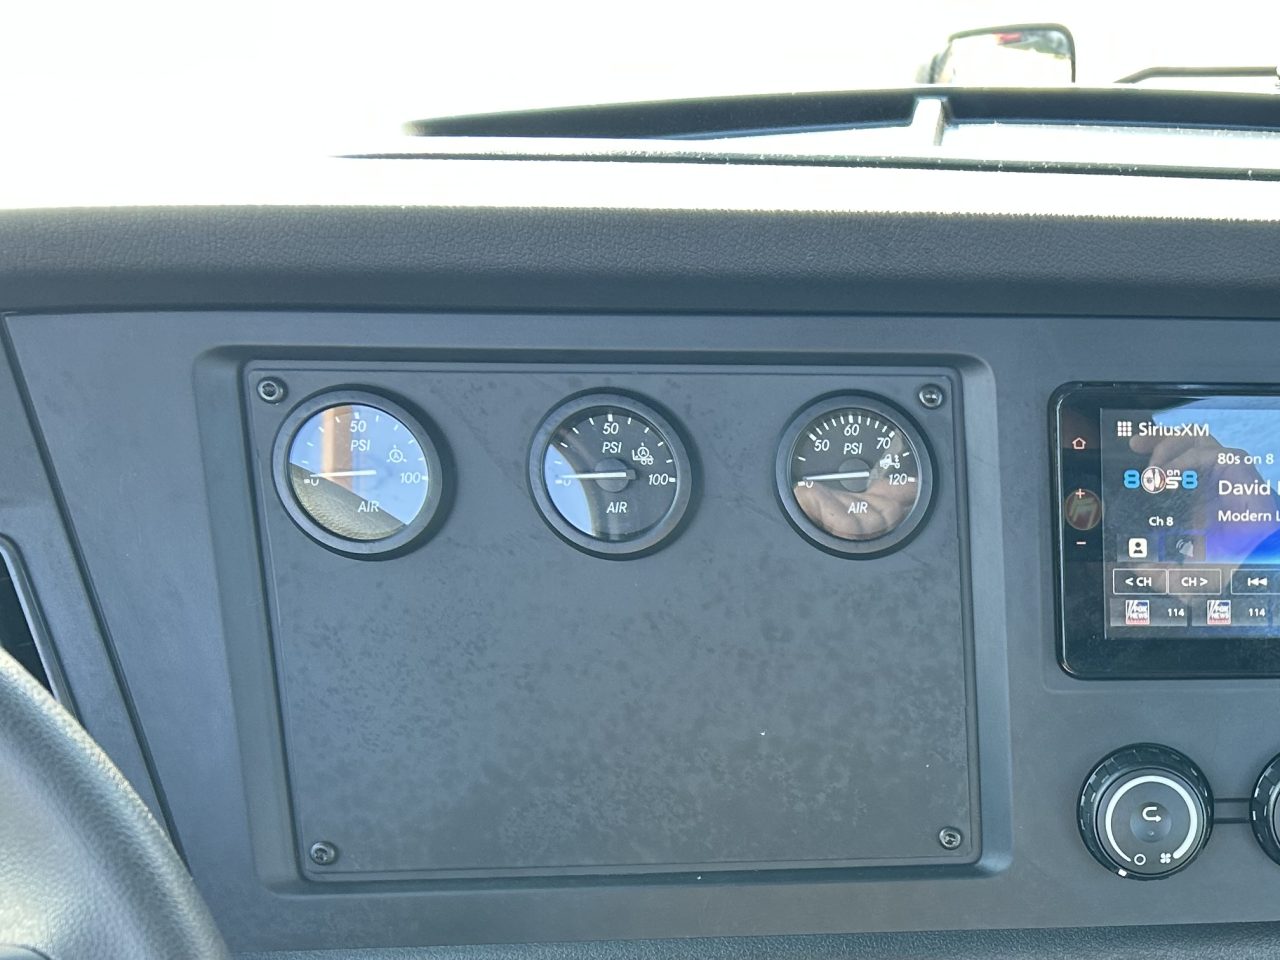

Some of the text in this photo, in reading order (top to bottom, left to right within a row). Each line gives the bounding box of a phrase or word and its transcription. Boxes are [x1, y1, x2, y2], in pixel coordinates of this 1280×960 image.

[350, 421, 367, 433] 50
[602, 423, 619, 435] 50
[844, 424, 860, 436] 60
[1138, 421, 1210, 437] SiriusXM
[350, 440, 371, 451] PSI
[602, 442, 622, 453] PSI
[814, 439, 830, 451] 50
[843, 443, 863, 454] PSI
[876, 437, 891, 449] 70
[1217, 453, 1274, 464] 80s on 8
[400, 472, 421, 484] 100
[649, 474, 668, 485] 100
[889, 474, 908, 485] 120
[1218, 480, 1271, 496] David
[358, 501, 380, 513] AIR
[606, 502, 628, 513] AIR
[847, 502, 868, 513] AIR
[1149, 516, 1174, 526] Ch 8
[1218, 510, 1272, 522] Modern
[1136, 577, 1152, 587] CH
[1181, 577, 1197, 587] CH
[1168, 608, 1185, 617] 114
[1249, 608, 1266, 617] 114
